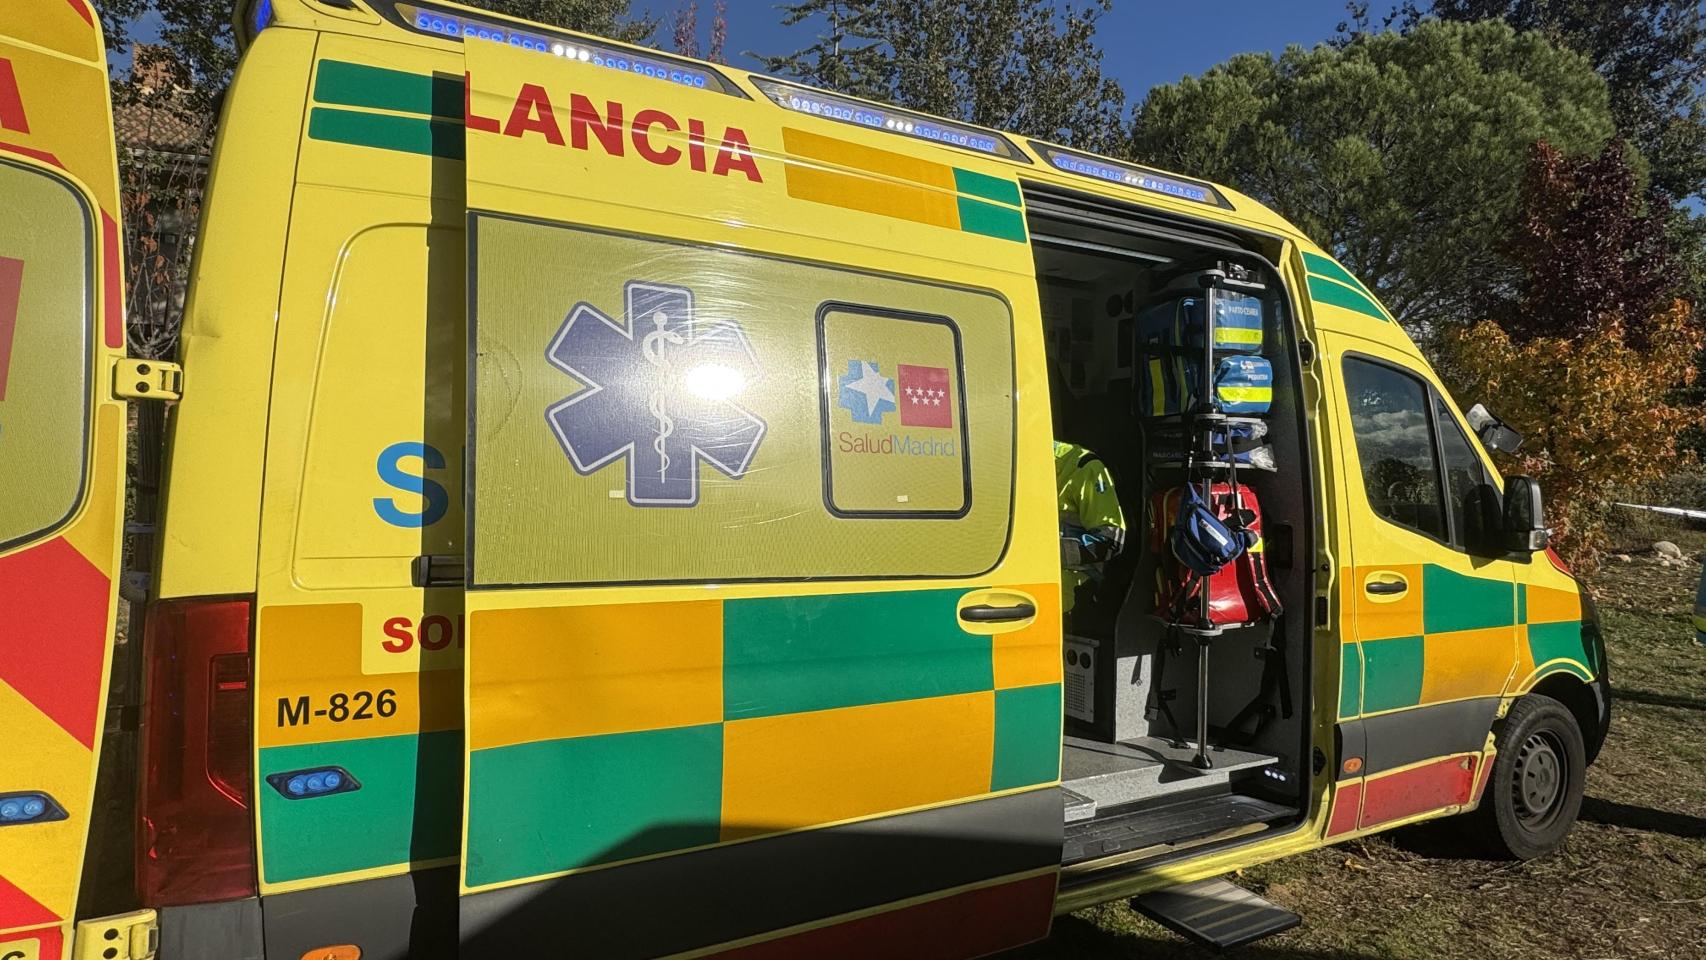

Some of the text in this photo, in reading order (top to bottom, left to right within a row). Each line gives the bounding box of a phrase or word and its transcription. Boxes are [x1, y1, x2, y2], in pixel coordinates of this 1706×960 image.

[372, 440, 465, 529] S
[381, 614, 465, 654] SO
[277, 688, 397, 728] M-826
